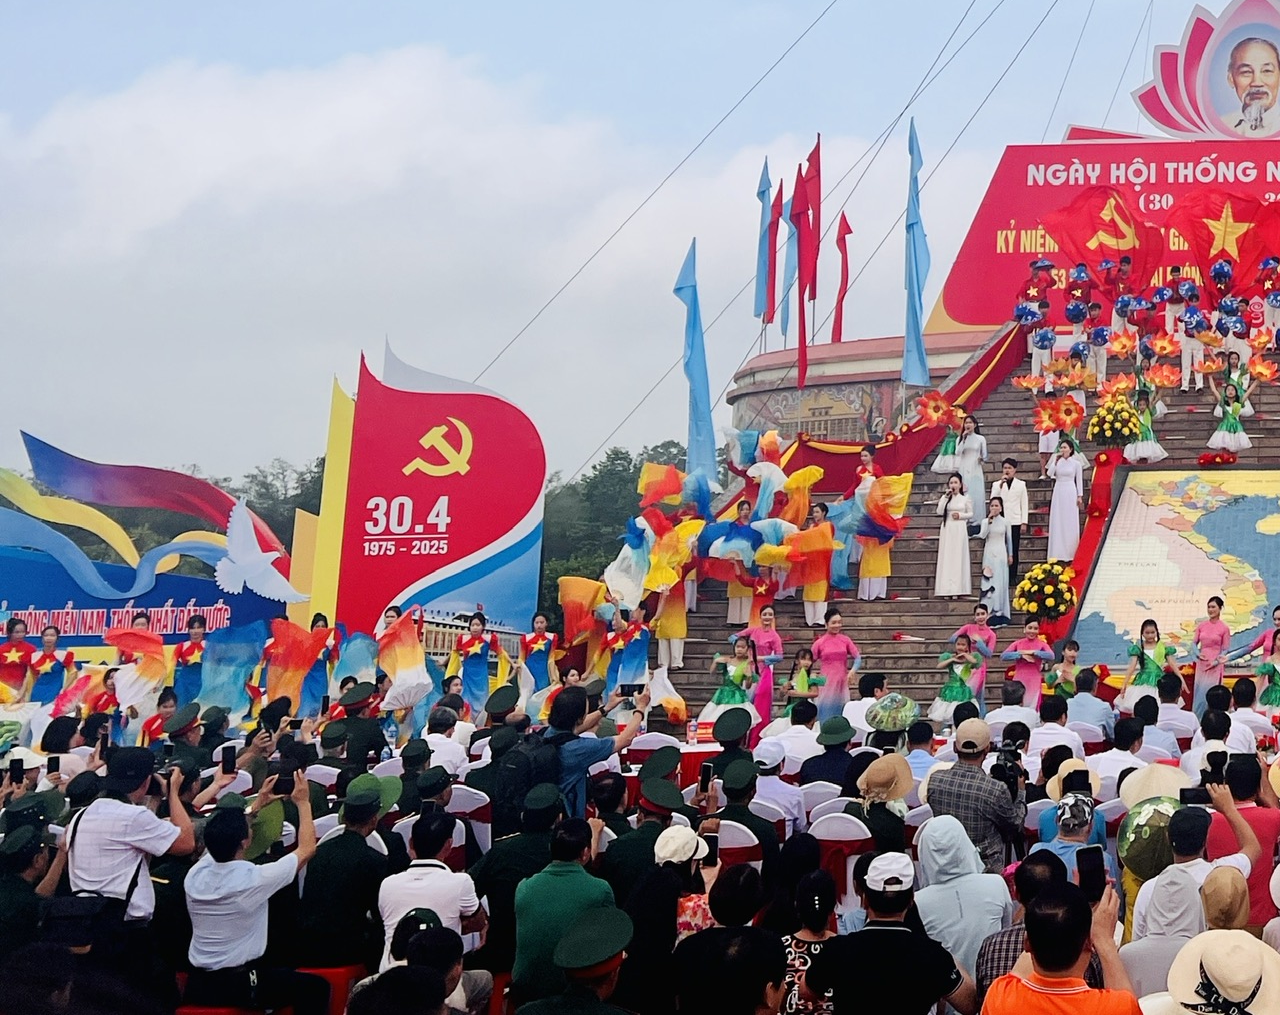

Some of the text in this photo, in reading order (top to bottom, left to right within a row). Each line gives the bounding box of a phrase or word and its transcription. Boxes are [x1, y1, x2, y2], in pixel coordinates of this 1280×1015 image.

[1027, 158, 1100, 186] NGÀY
[1110, 157, 1156, 192] HỘI
[1164, 153, 1258, 183] THỐNG
[996, 219, 1017, 254] KỶ
[1020, 224, 1059, 258] NIỆM
[364, 495, 452, 535] 30.4
[363, 541, 396, 556] 1975
[411, 540, 448, 555] 2025
[49, 600, 79, 636] MIỀN
[110, 599, 146, 631] THỐ
[147, 598, 177, 634] NHẤT
